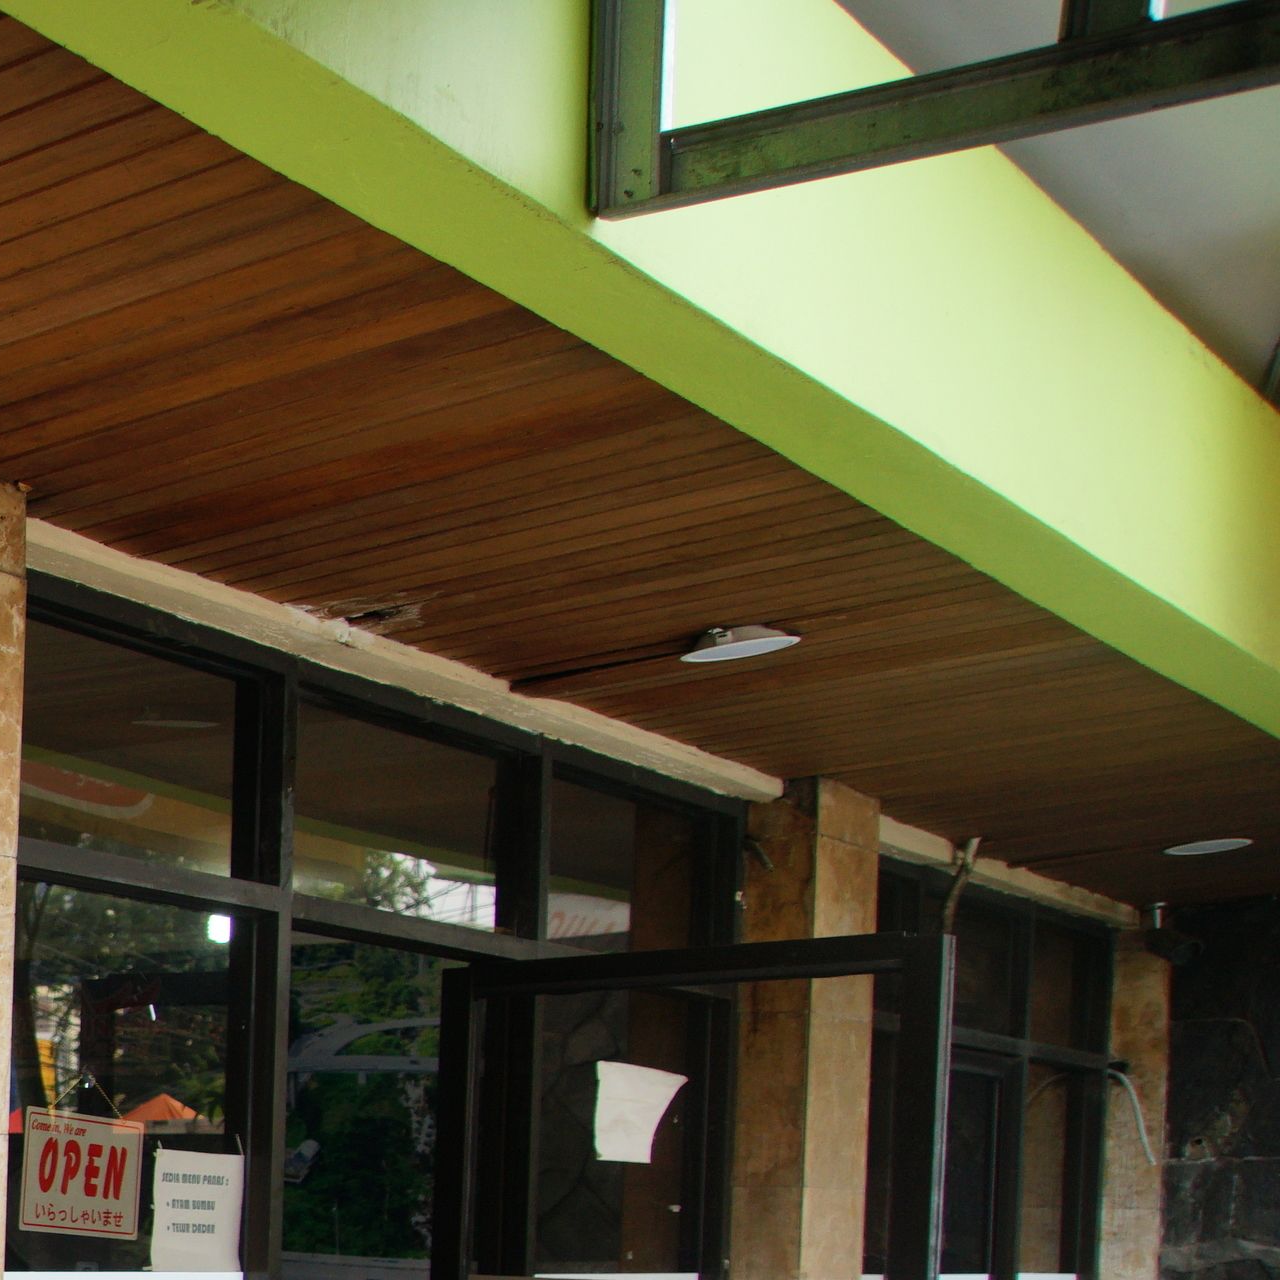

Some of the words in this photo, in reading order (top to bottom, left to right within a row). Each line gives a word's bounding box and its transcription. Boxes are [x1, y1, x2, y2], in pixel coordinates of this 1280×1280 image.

[74, 1127, 87, 1137] are
[38, 1137, 128, 1200] OPEN
[181, 1173, 201, 1184] MENU
[35, 1203, 124, 1228] いらっしゃいませ
